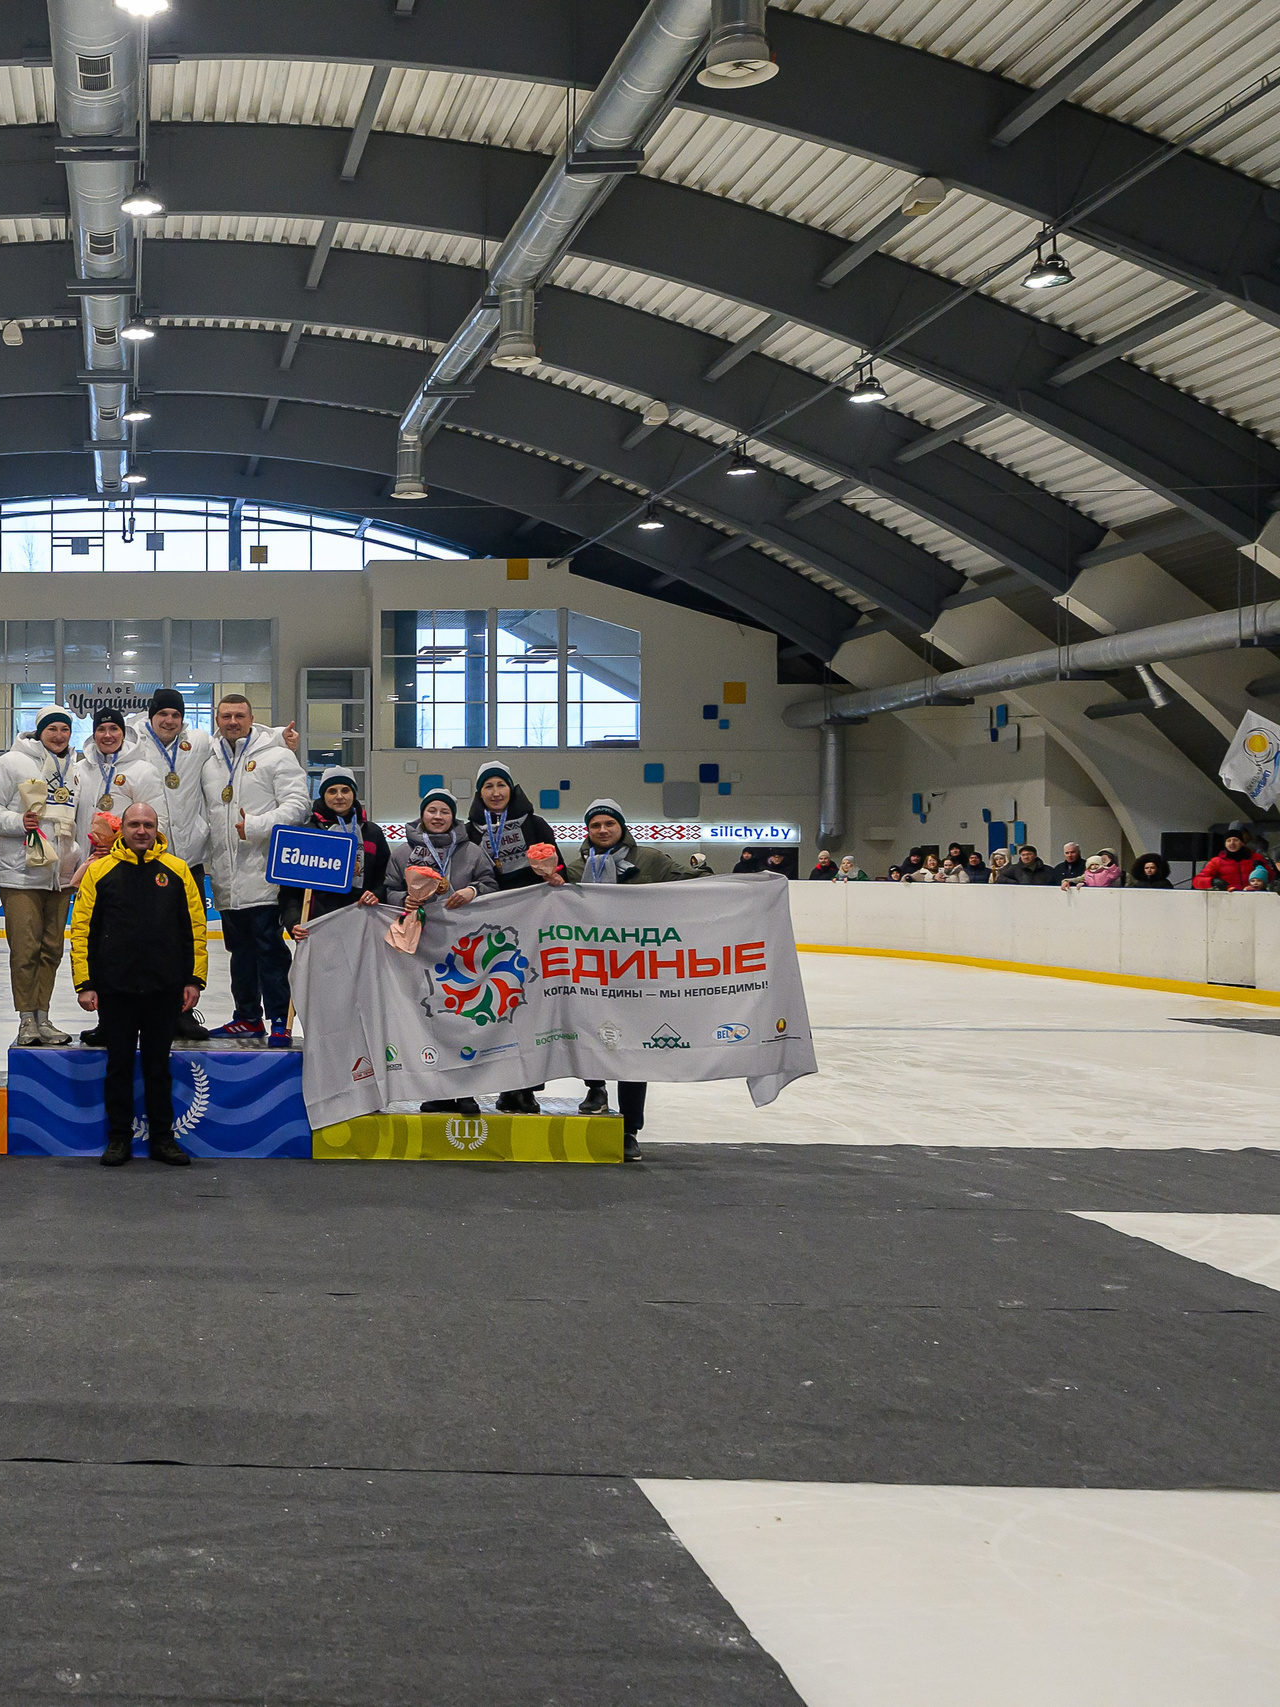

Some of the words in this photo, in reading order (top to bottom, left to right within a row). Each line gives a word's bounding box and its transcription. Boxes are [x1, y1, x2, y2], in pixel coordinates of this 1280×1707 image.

[97, 686, 131, 695] КАФЕ
[710, 825, 791, 840] silichy.by
[281, 847, 342, 871] Единые
[538, 925, 682, 947] КОМАНДА
[540, 941, 767, 986] ЕДИНЫЕ
[543, 985, 577, 998] КОГДА
[580, 986, 599, 997] МЫ
[601, 988, 643, 999] ЕДИНЫ
[659, 989, 681, 998] МЫ
[684, 980, 768, 998] НЕПОБЕДИМЫ!
[452, 1119, 482, 1139] III
